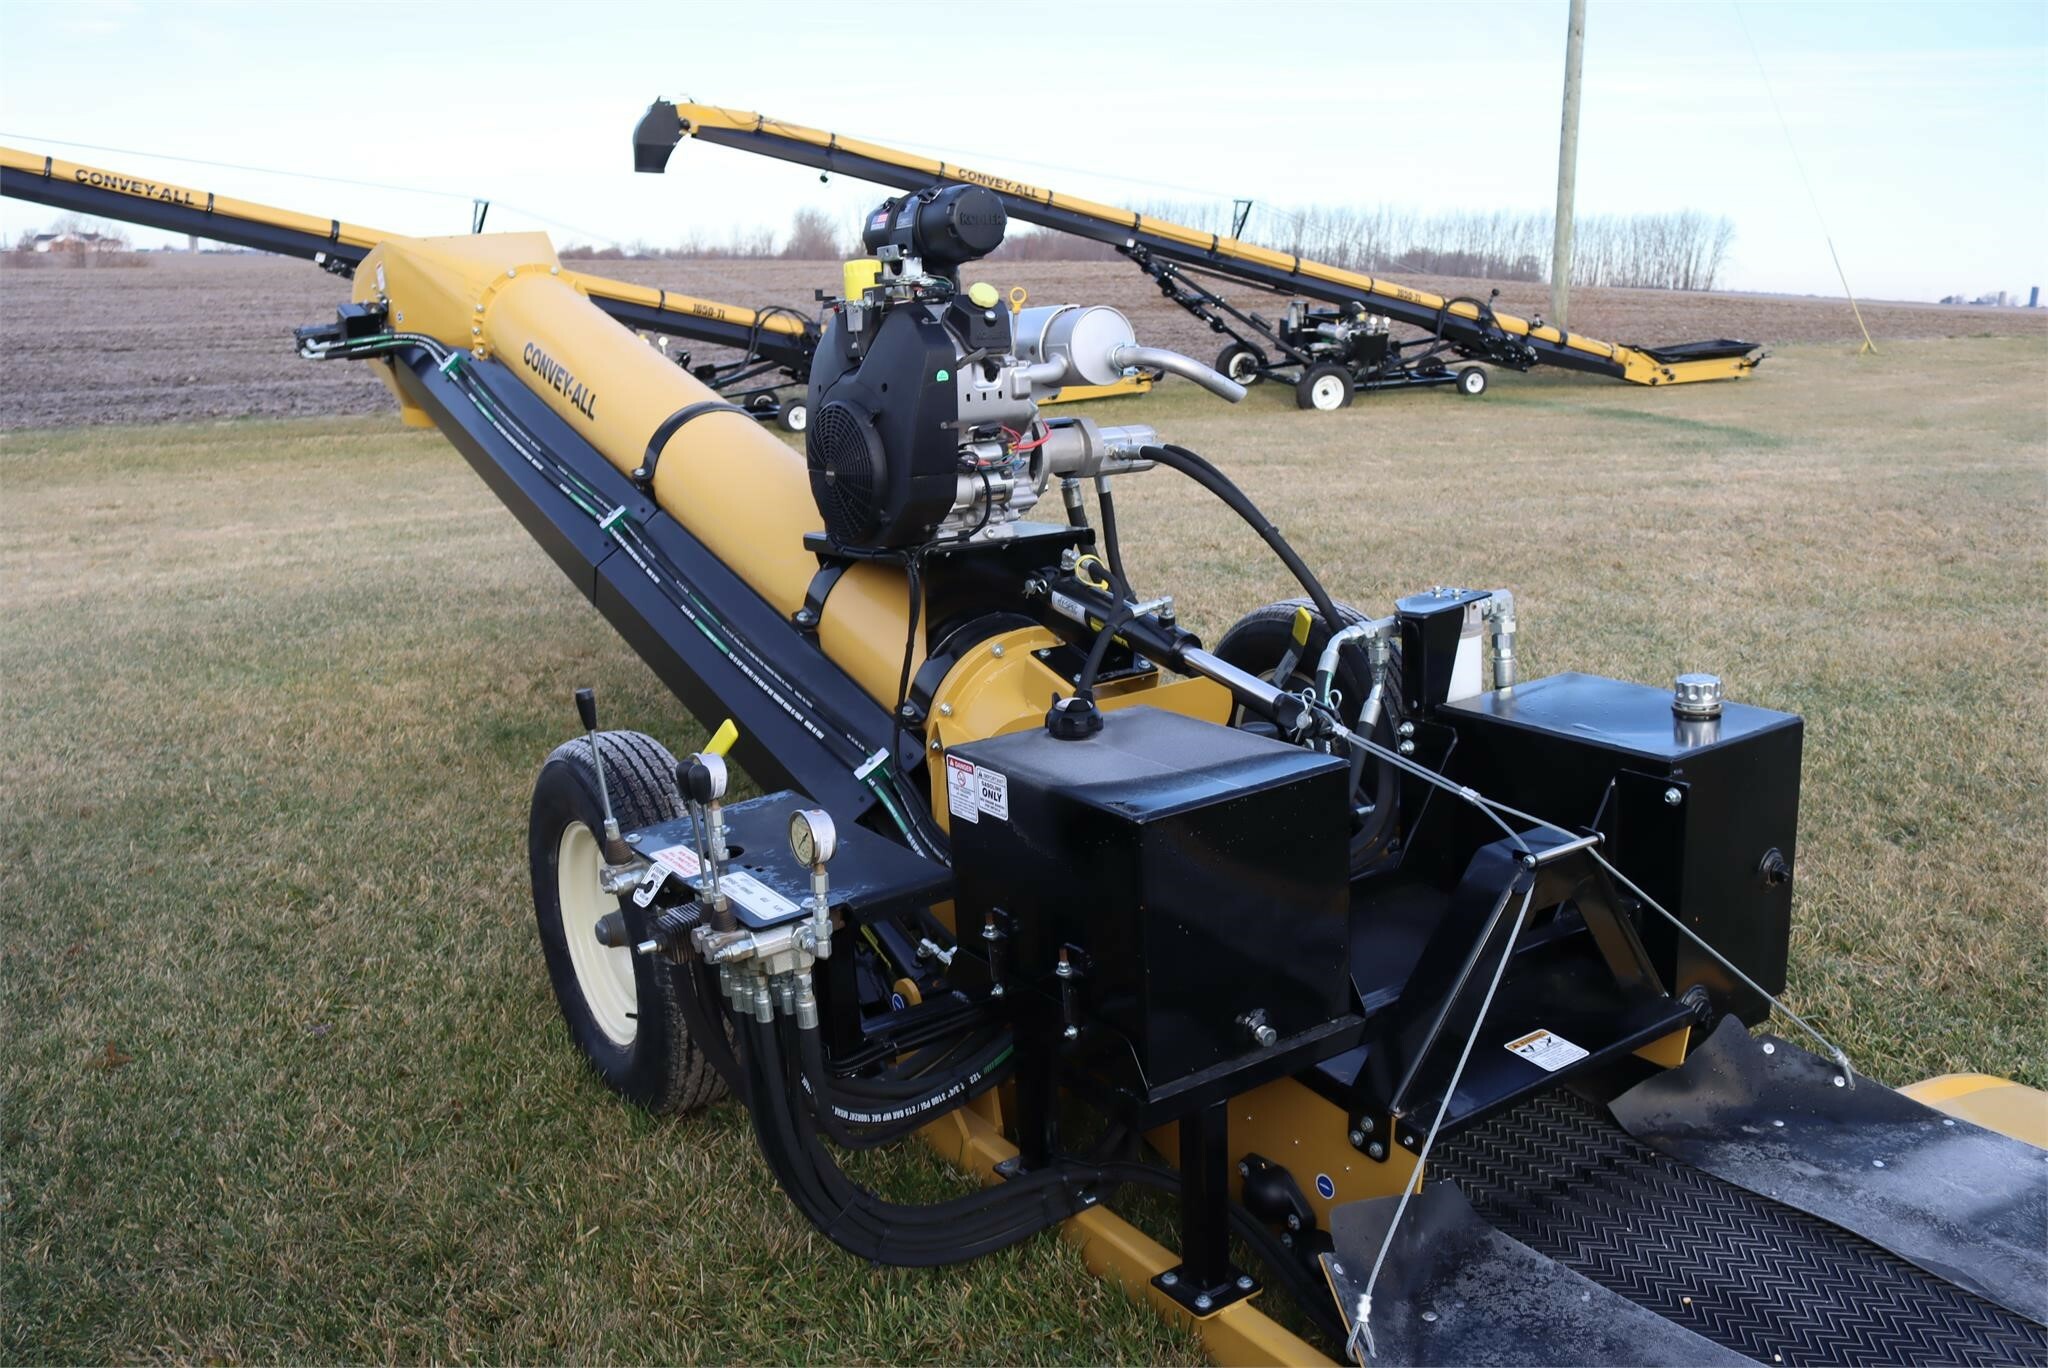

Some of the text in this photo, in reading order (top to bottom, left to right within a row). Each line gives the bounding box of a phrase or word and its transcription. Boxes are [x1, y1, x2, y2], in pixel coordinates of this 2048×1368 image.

[75, 168, 195, 206] CONVEY-ALL
[958, 168, 1038, 198] CONVEY-ALL
[523, 342, 596, 421] CONVEY-ALL
[982, 788, 1002, 802] ONLY
[893, 1108, 904, 1120] BAR
[921, 1100, 931, 1111] PSI
